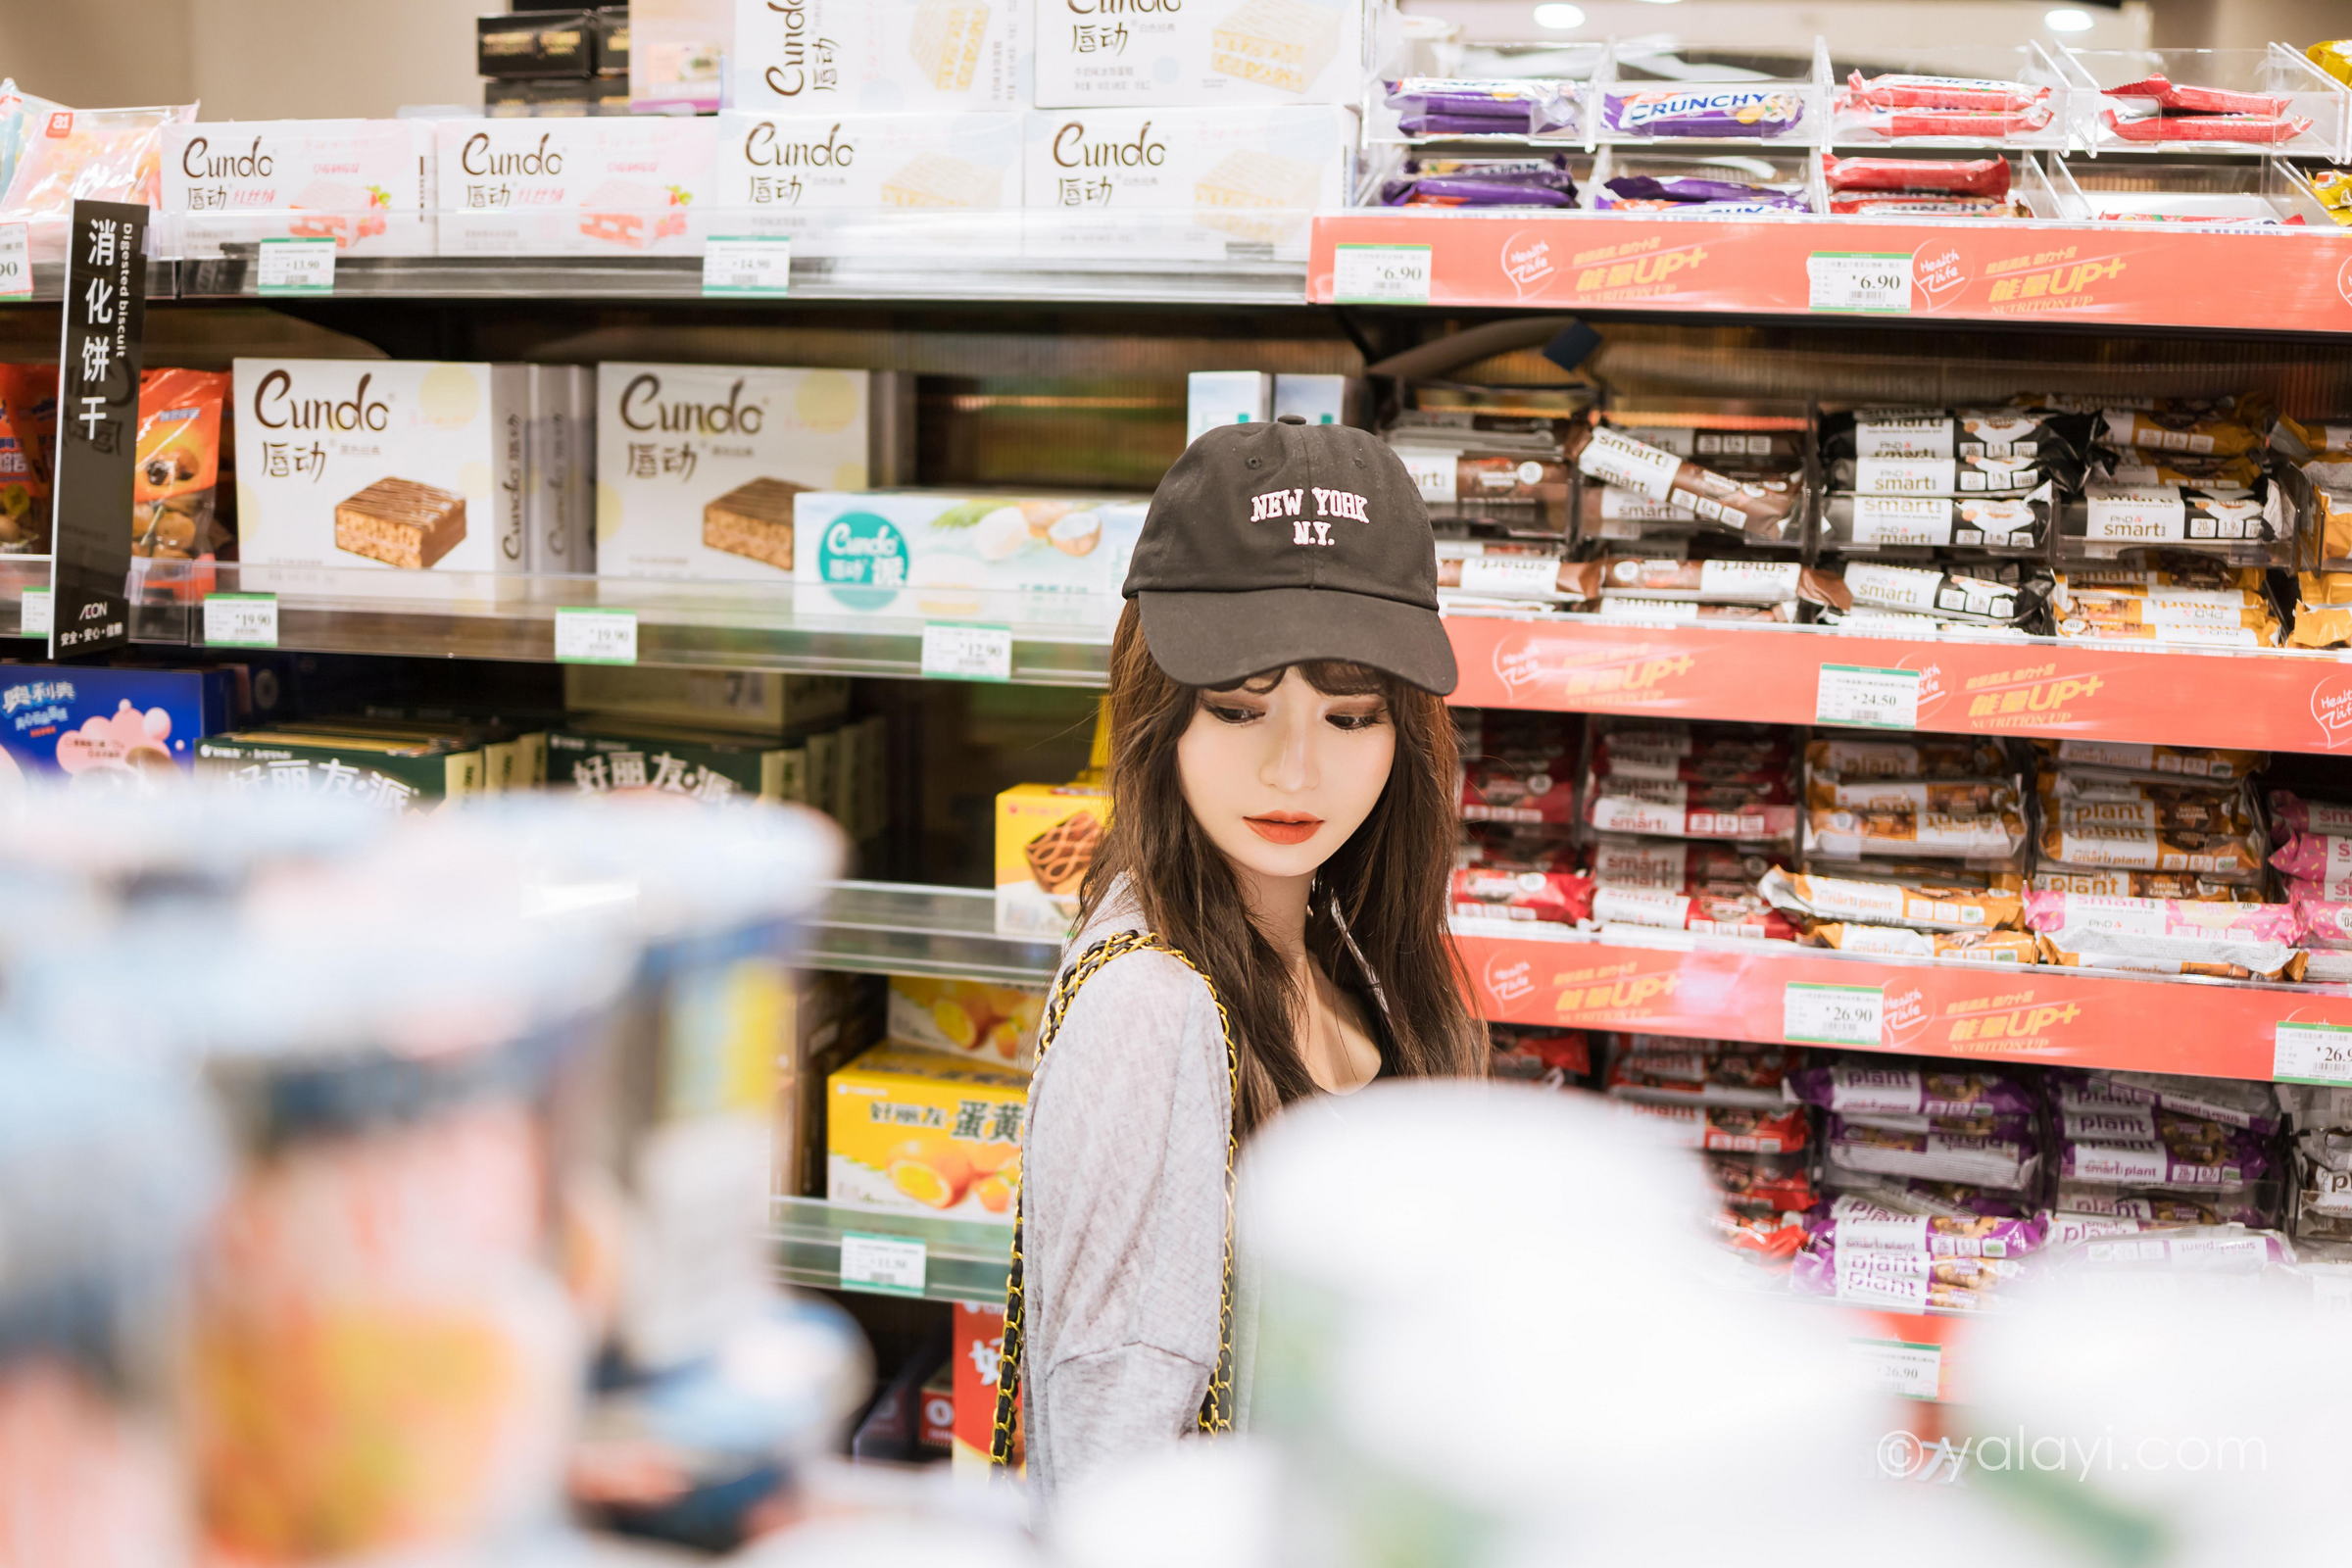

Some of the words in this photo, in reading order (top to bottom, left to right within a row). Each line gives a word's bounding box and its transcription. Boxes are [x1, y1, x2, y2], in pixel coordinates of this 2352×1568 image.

[1072, 23, 1128, 55] 唇动
[1631, 93, 1770, 121] CRUNCHY
[182, 135, 273, 179] Cundo
[462, 132, 564, 176] Cundo
[745, 121, 854, 167] Cundo
[1054, 122, 1165, 168] Cundo
[187, 185, 227, 210] 唇动
[466, 183, 511, 208] 唇动
[749, 174, 802, 206] 唇动
[1058, 176, 1112, 207] 唇动
[120, 223, 133, 297] Digested
[1920, 250, 1961, 272] Health
[1988, 257, 2127, 303] 能量UP+
[1991, 298, 2065, 316] NUTRITION
[2069, 295, 2094, 309] UP
[78, 219, 116, 441] 消化饼干
[116, 300, 130, 358] biscuit
[255, 368, 389, 431] Cundo
[619, 372, 764, 434] Cundo
[262, 441, 325, 483] 唇动
[626, 441, 698, 483] 唇动
[1599, 435, 1663, 466] smart
[1413, 472, 1438, 486] art
[1595, 466, 1645, 492] smart
[1875, 476, 1930, 490] smart
[1250, 489, 1304, 523] NEW
[1311, 486, 1370, 524] YORK
[1619, 504, 1672, 518] smart
[1865, 499, 1933, 514] smart
[827, 522, 899, 557] Cundo
[1294, 520, 1335, 546] N.Y.
[2104, 522, 2160, 537] smart
[1859, 583, 1914, 604] smart
[1969, 674, 2104, 717] 能量UP+
[2321, 690, 2352, 710] Healt
[1971, 712, 2043, 730] NUTRITION
[2047, 711, 2072, 725] UP
[2076, 802, 2146, 823] plant
[2050, 873, 2119, 897] plant
[1949, 1003, 2081, 1042] 能量UP+
[1952, 1039, 2024, 1054] NUTRITION
[2028, 1038, 2050, 1051] UP
[2325, 1045, 2352, 1064] 26.9
[2081, 1115, 2146, 1133] plant
[2125, 1164, 2157, 1177] plant
